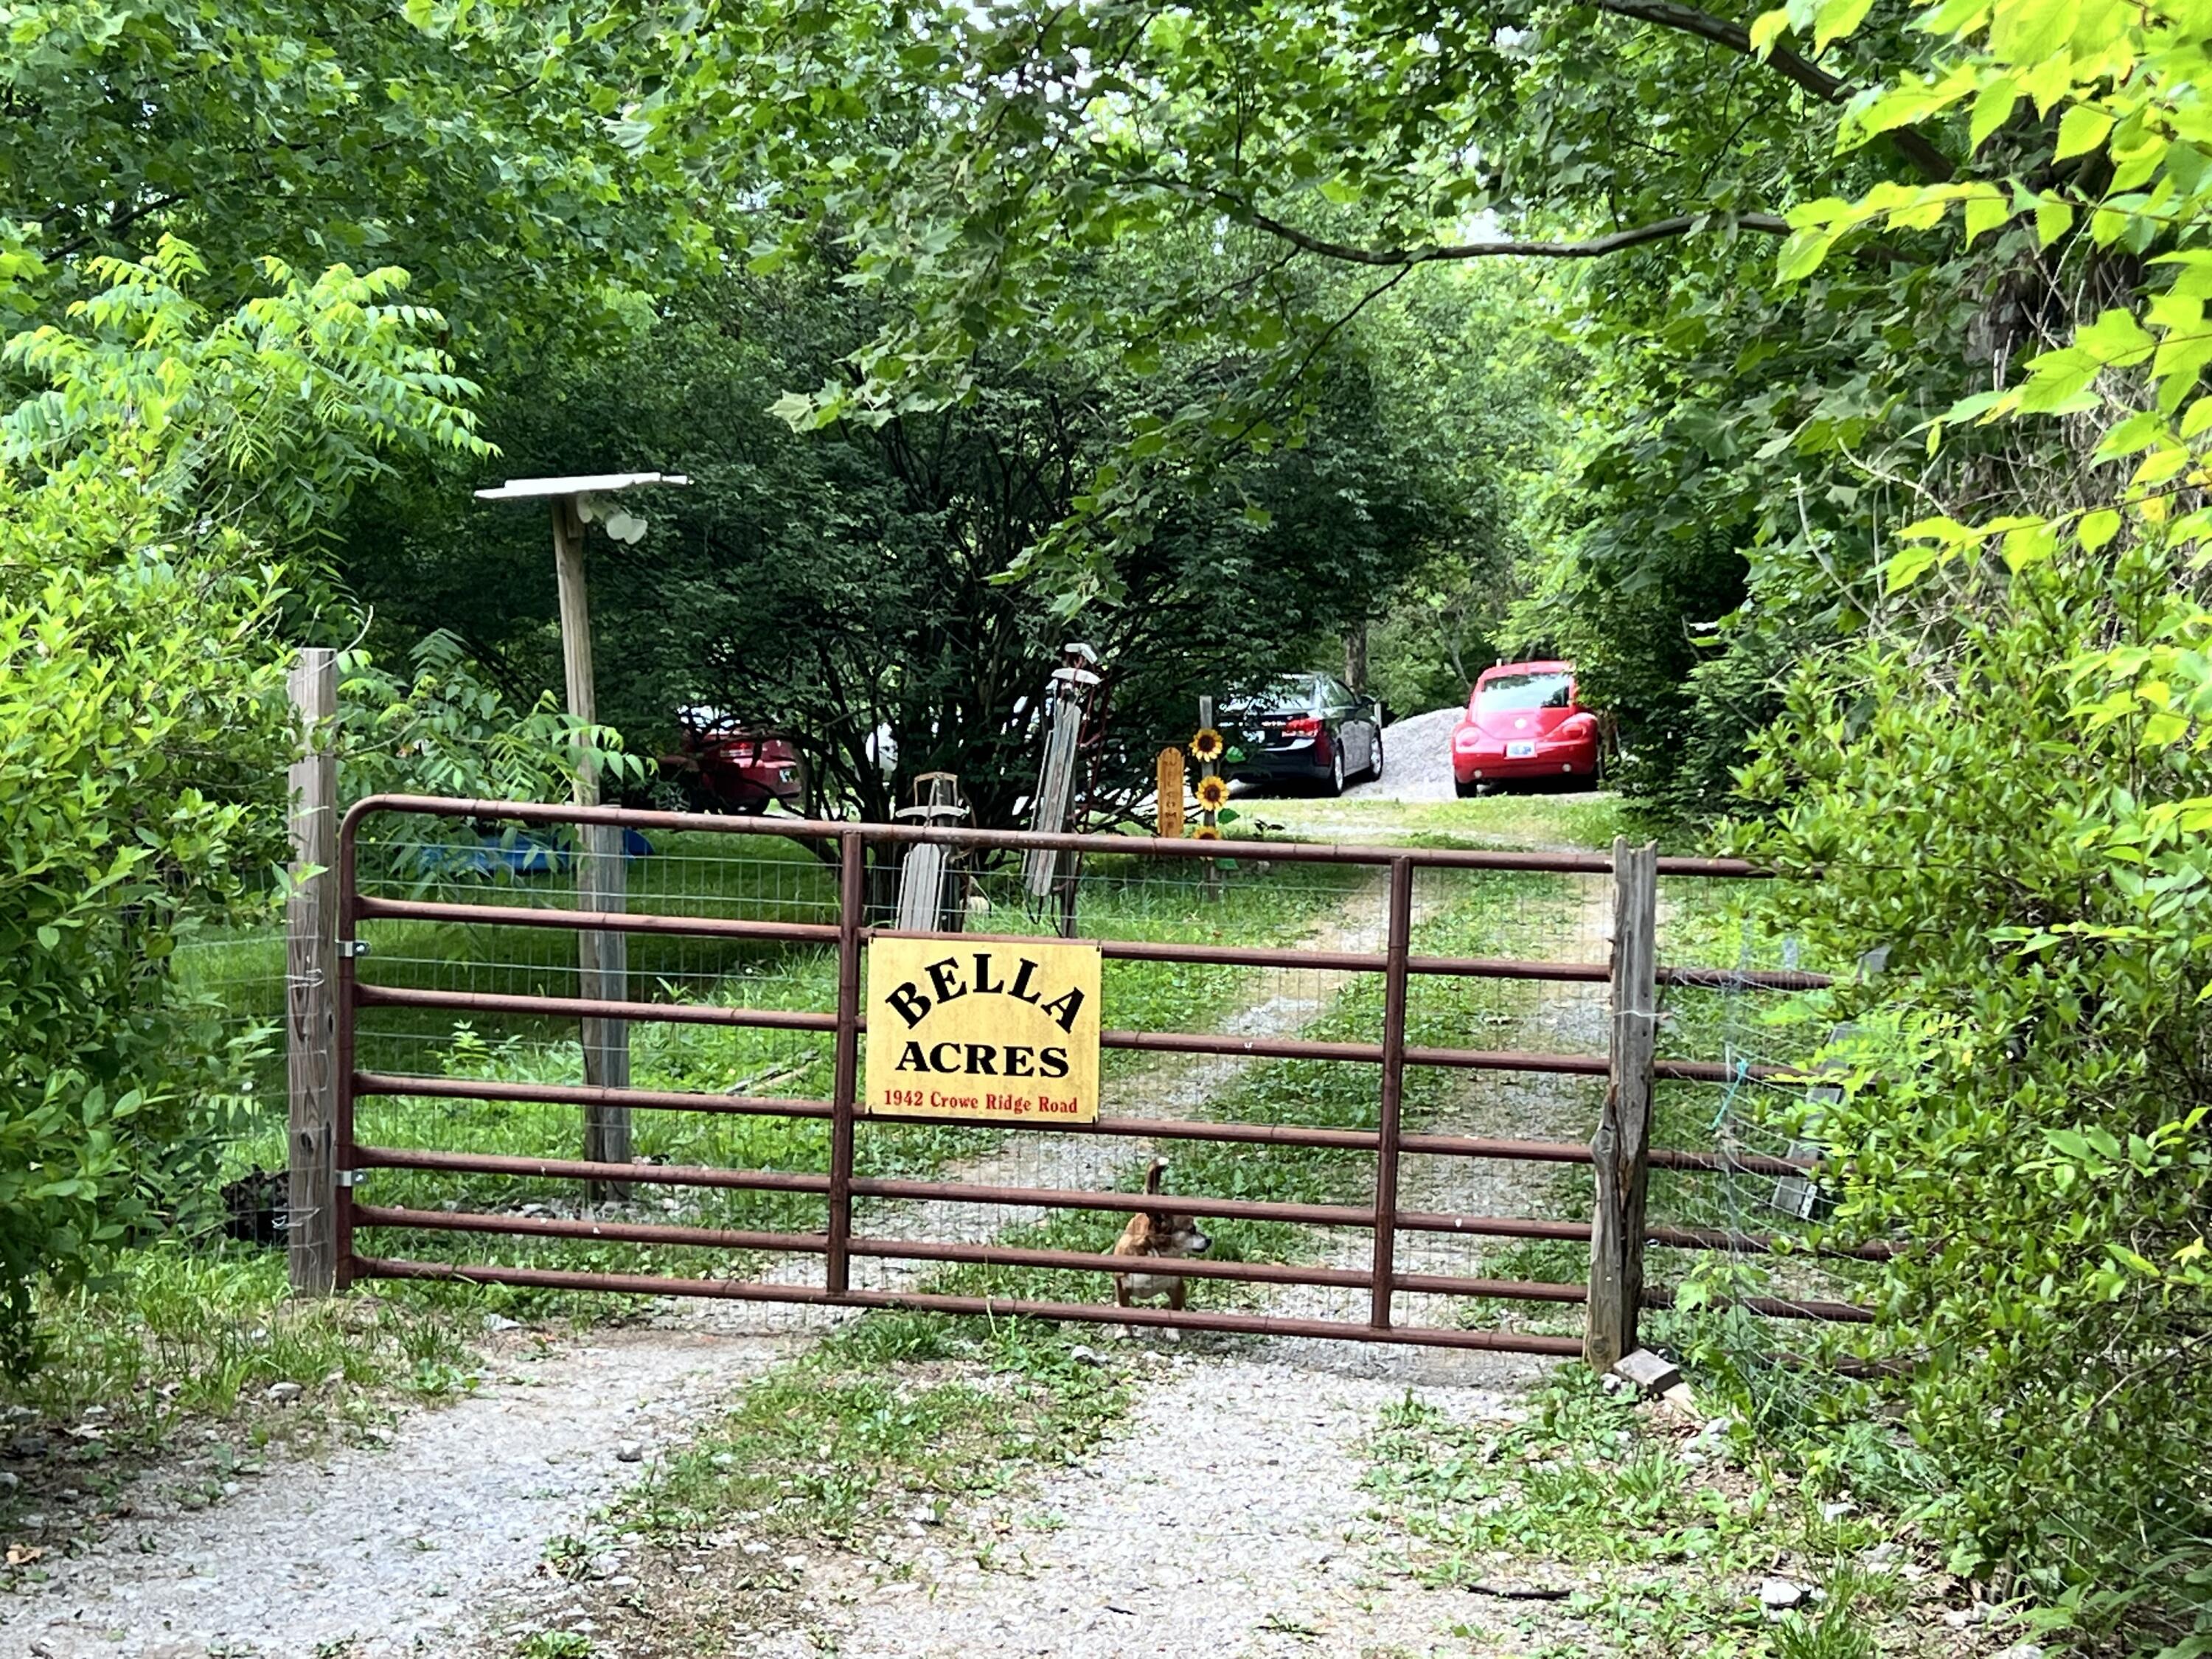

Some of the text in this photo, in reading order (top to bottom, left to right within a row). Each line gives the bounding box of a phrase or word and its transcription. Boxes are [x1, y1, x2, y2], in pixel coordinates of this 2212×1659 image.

[885, 953, 1085, 1034] BELLA
[894, 1041, 1069, 1078] ACRES
[884, 1090, 1078, 1114] 1942 Crowe Ridge Road
